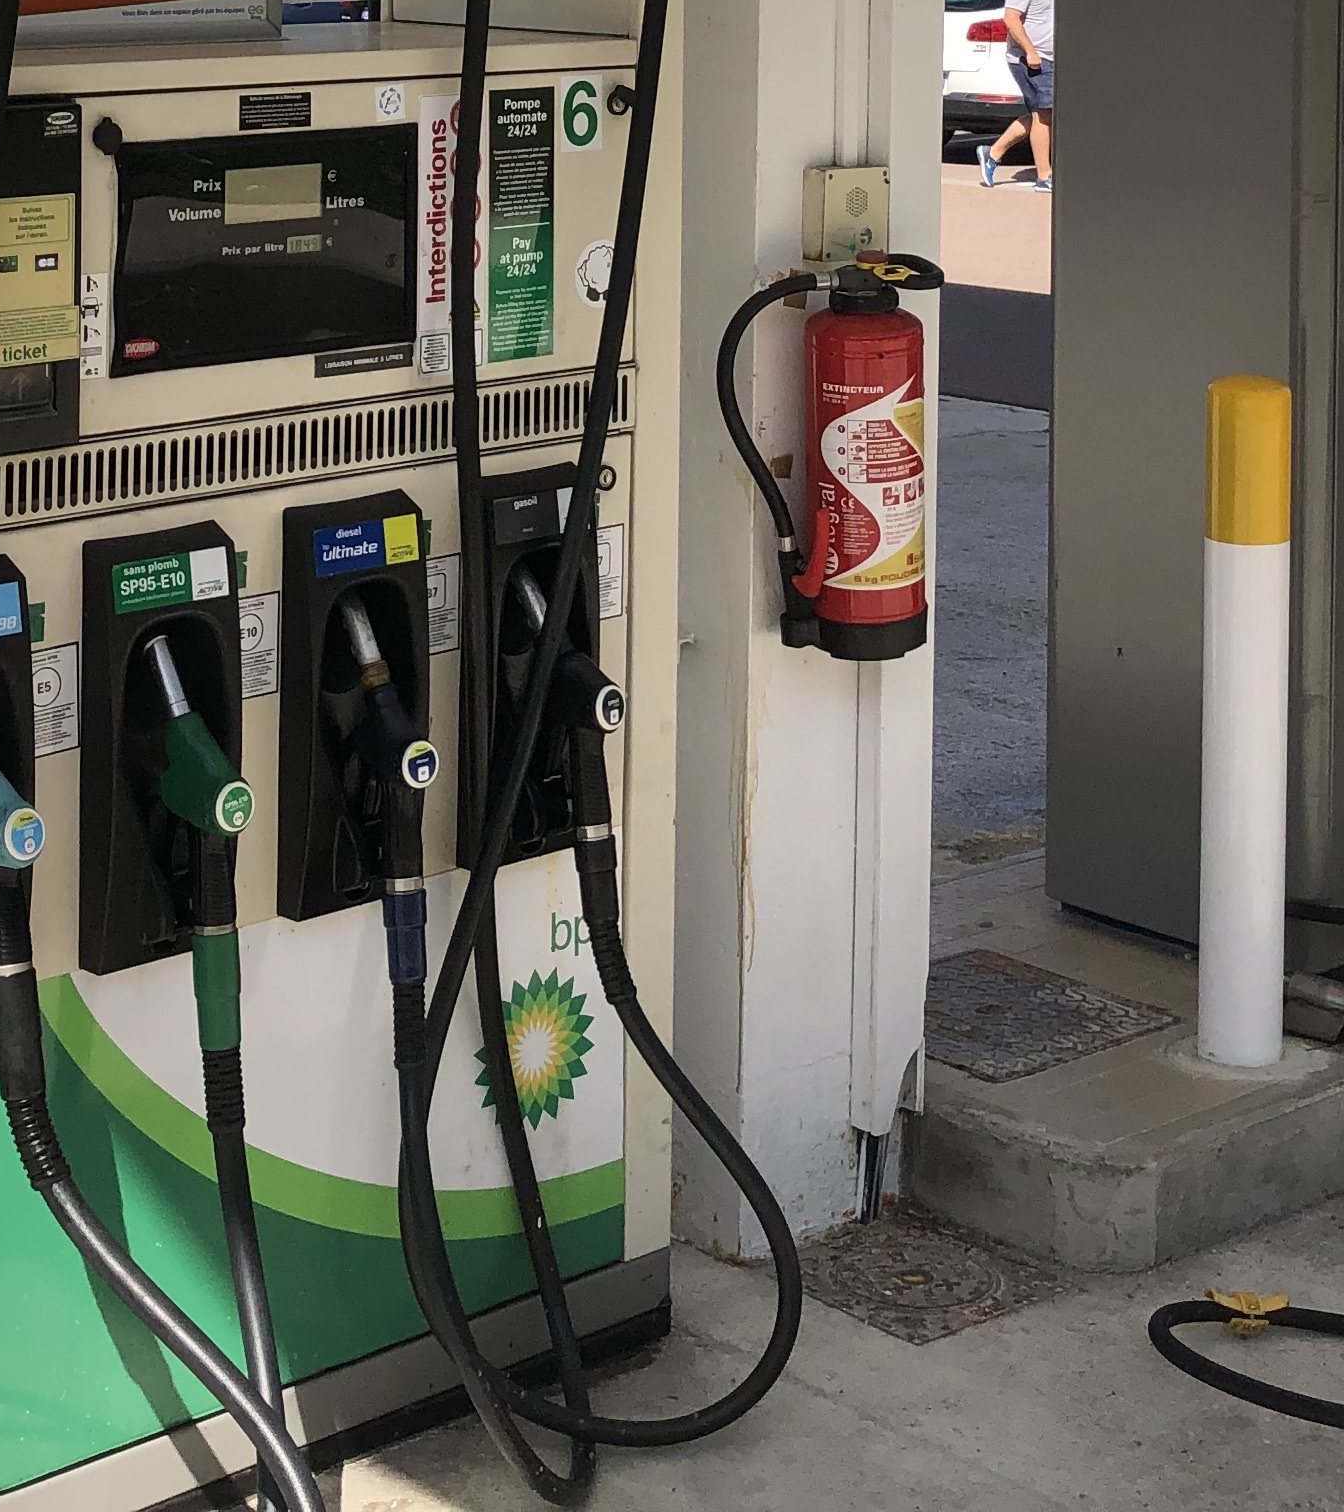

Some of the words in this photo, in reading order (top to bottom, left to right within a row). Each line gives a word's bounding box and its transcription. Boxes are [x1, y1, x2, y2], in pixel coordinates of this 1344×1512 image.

[504, 98, 541, 112] Pompe
[497, 111, 547, 125] automate
[563, 80, 598, 147] 6
[507, 124, 537, 138] 24/24
[193, 179, 221, 192] Prix
[168, 208, 221, 222] Volume
[326, 196, 365, 209] Litres
[425, 118, 447, 304] Interdictions
[222, 246, 241, 256] Prix
[245, 245, 261, 256] par
[265, 242, 284, 252] litre
[512, 237, 531, 251] Pay
[499, 253, 512, 263] at
[513, 251, 544, 264] pump
[507, 264, 537, 277] 24/24
[2, 343, 47, 363] ticket
[822, 382, 884, 394] EXTINCTEUR
[514, 496, 538, 510] gasoil
[336, 525, 362, 539] diesel
[323, 541, 378, 562] ultimate
[124, 563, 146, 576] sans
[148, 558, 179, 575] plomb
[120, 571, 185, 596] SP95-E10
[37, 681, 52, 694] E5
[551, 912, 591, 957] bp
